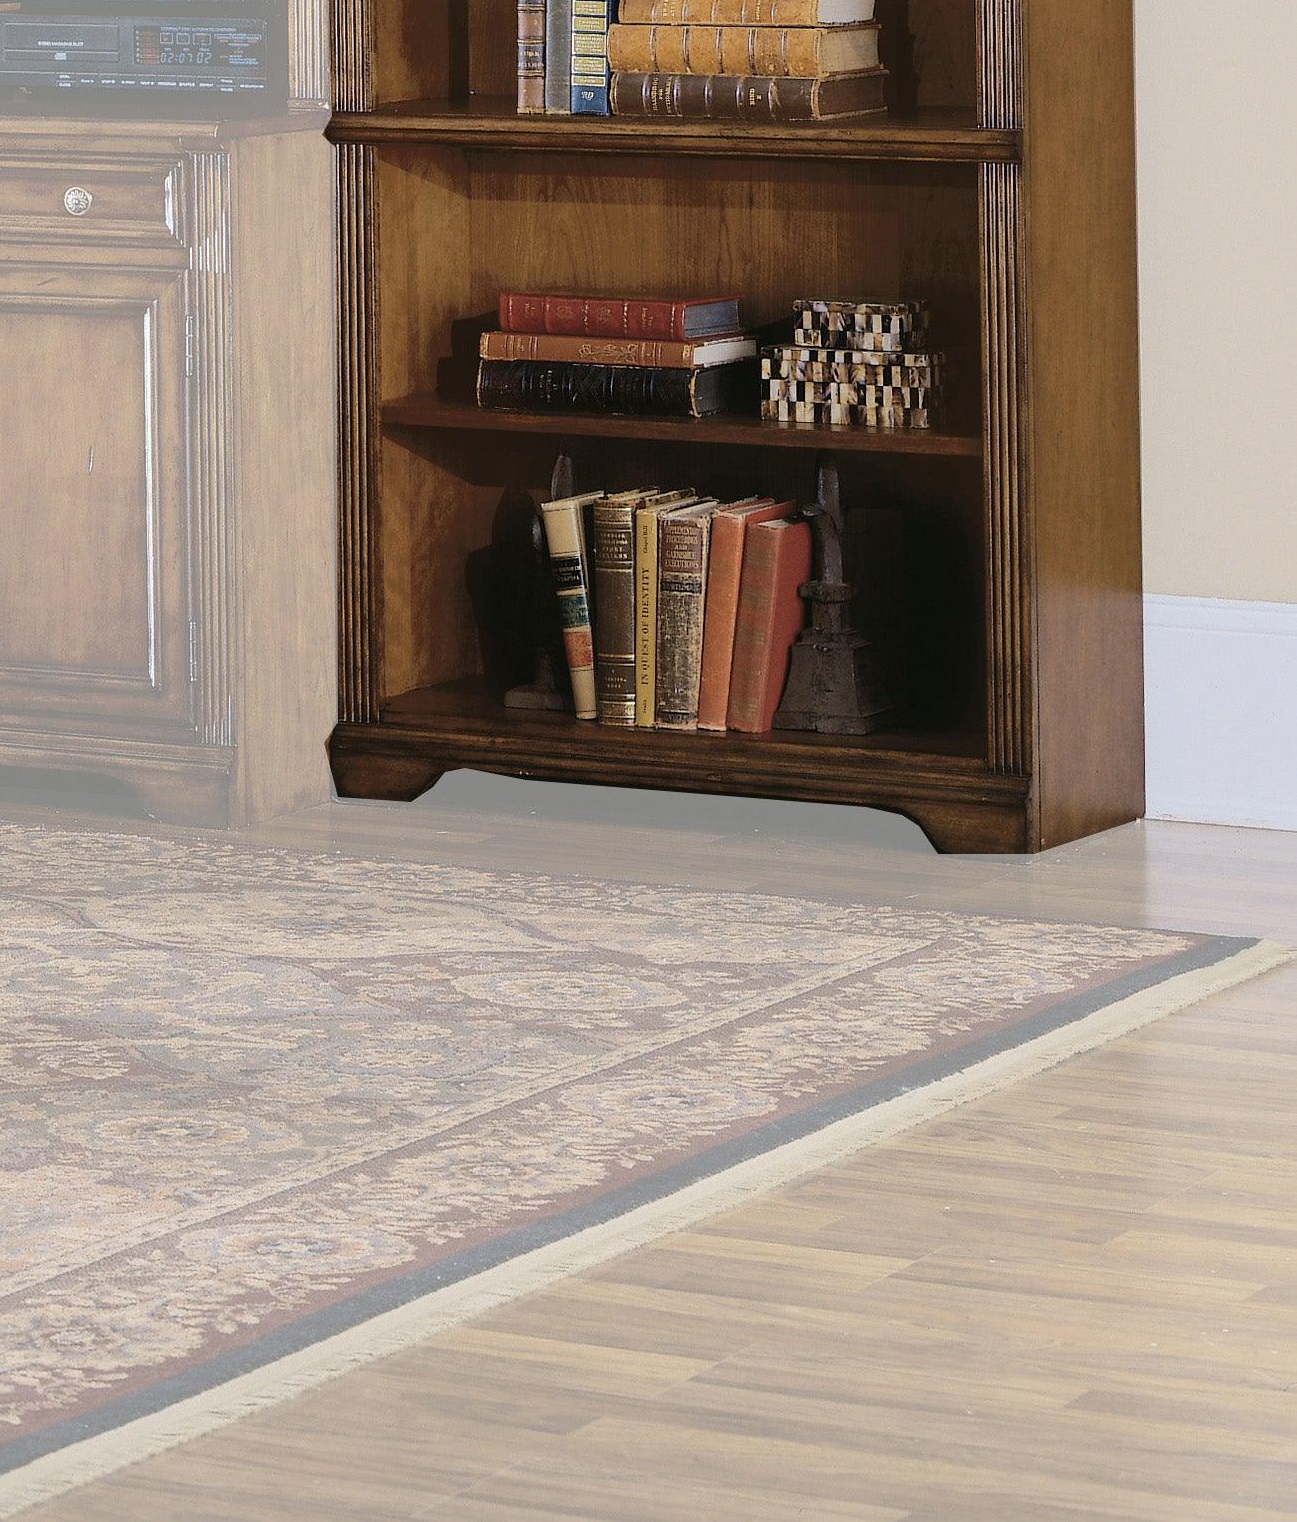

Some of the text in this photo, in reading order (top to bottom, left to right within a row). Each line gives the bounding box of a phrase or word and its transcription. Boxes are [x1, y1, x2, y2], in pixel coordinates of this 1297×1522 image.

[641, 567, 650, 686] IN QUEST OF IDENTITY
